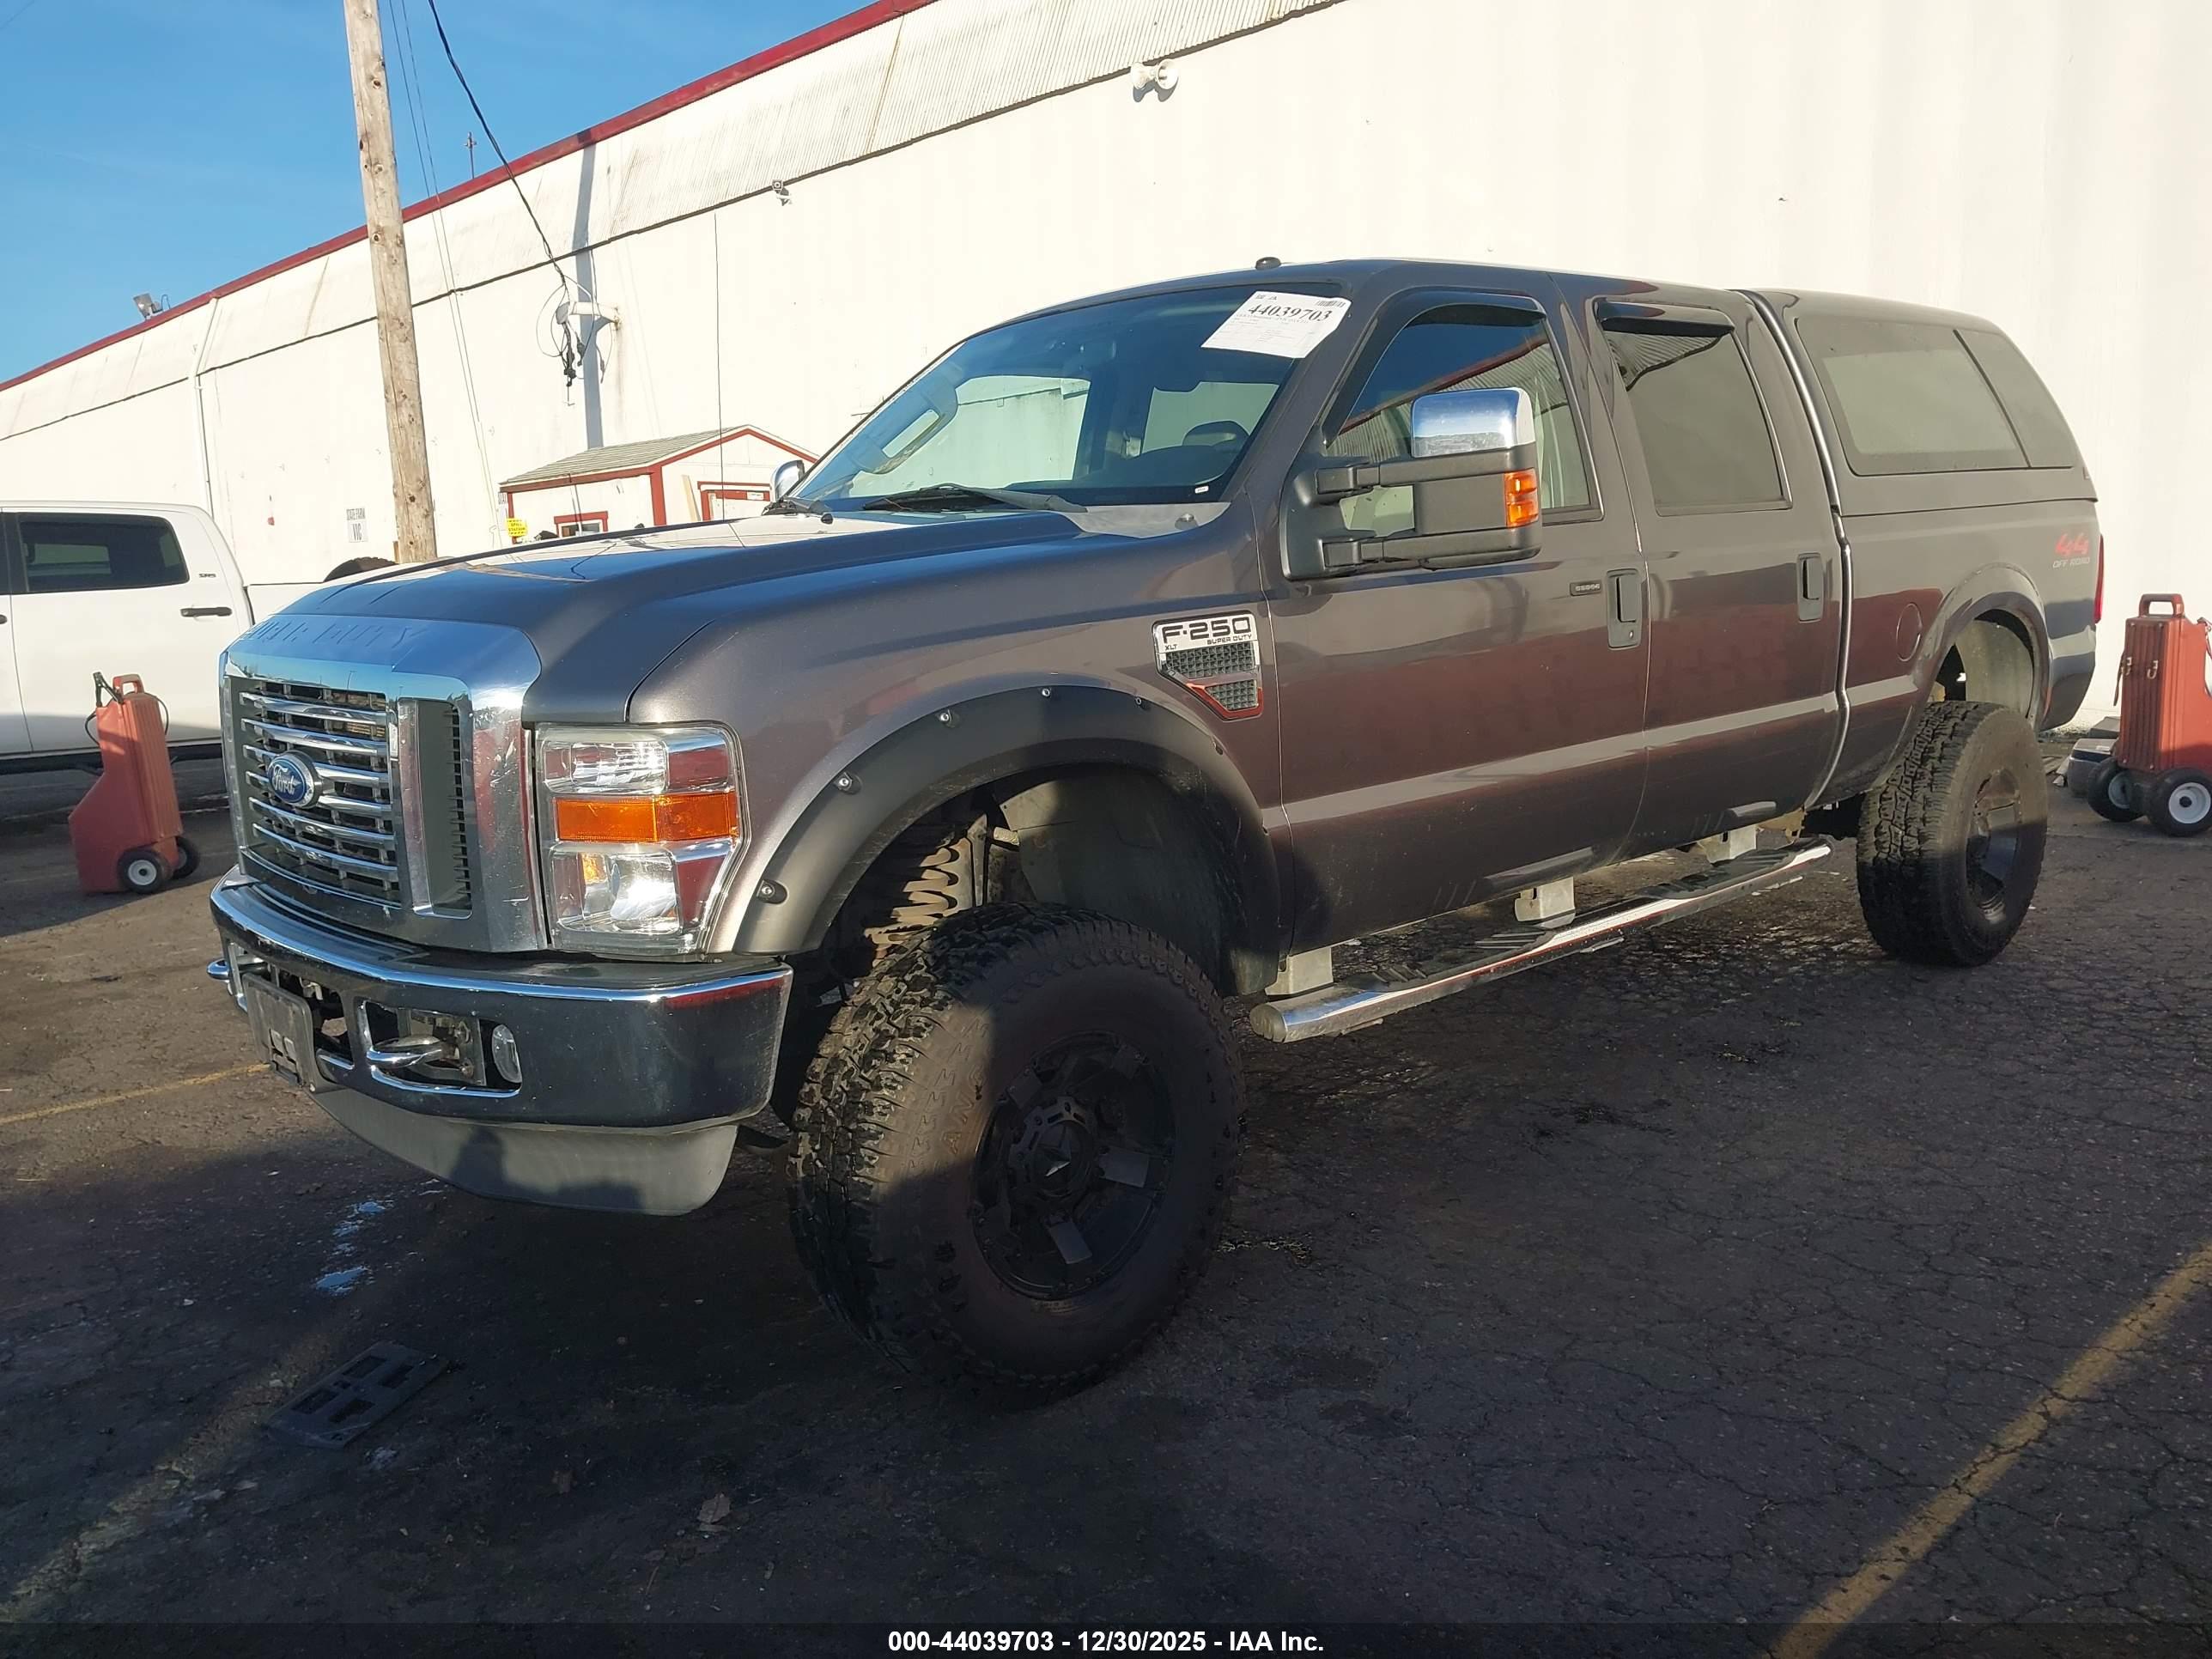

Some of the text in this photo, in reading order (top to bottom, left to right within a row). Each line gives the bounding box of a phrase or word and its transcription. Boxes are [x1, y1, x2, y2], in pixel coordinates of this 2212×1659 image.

[1248, 304, 1333, 322] 44039703
[1206, 633, 1252, 646] SUPER DUTY
[271, 763, 302, 795] Ford
